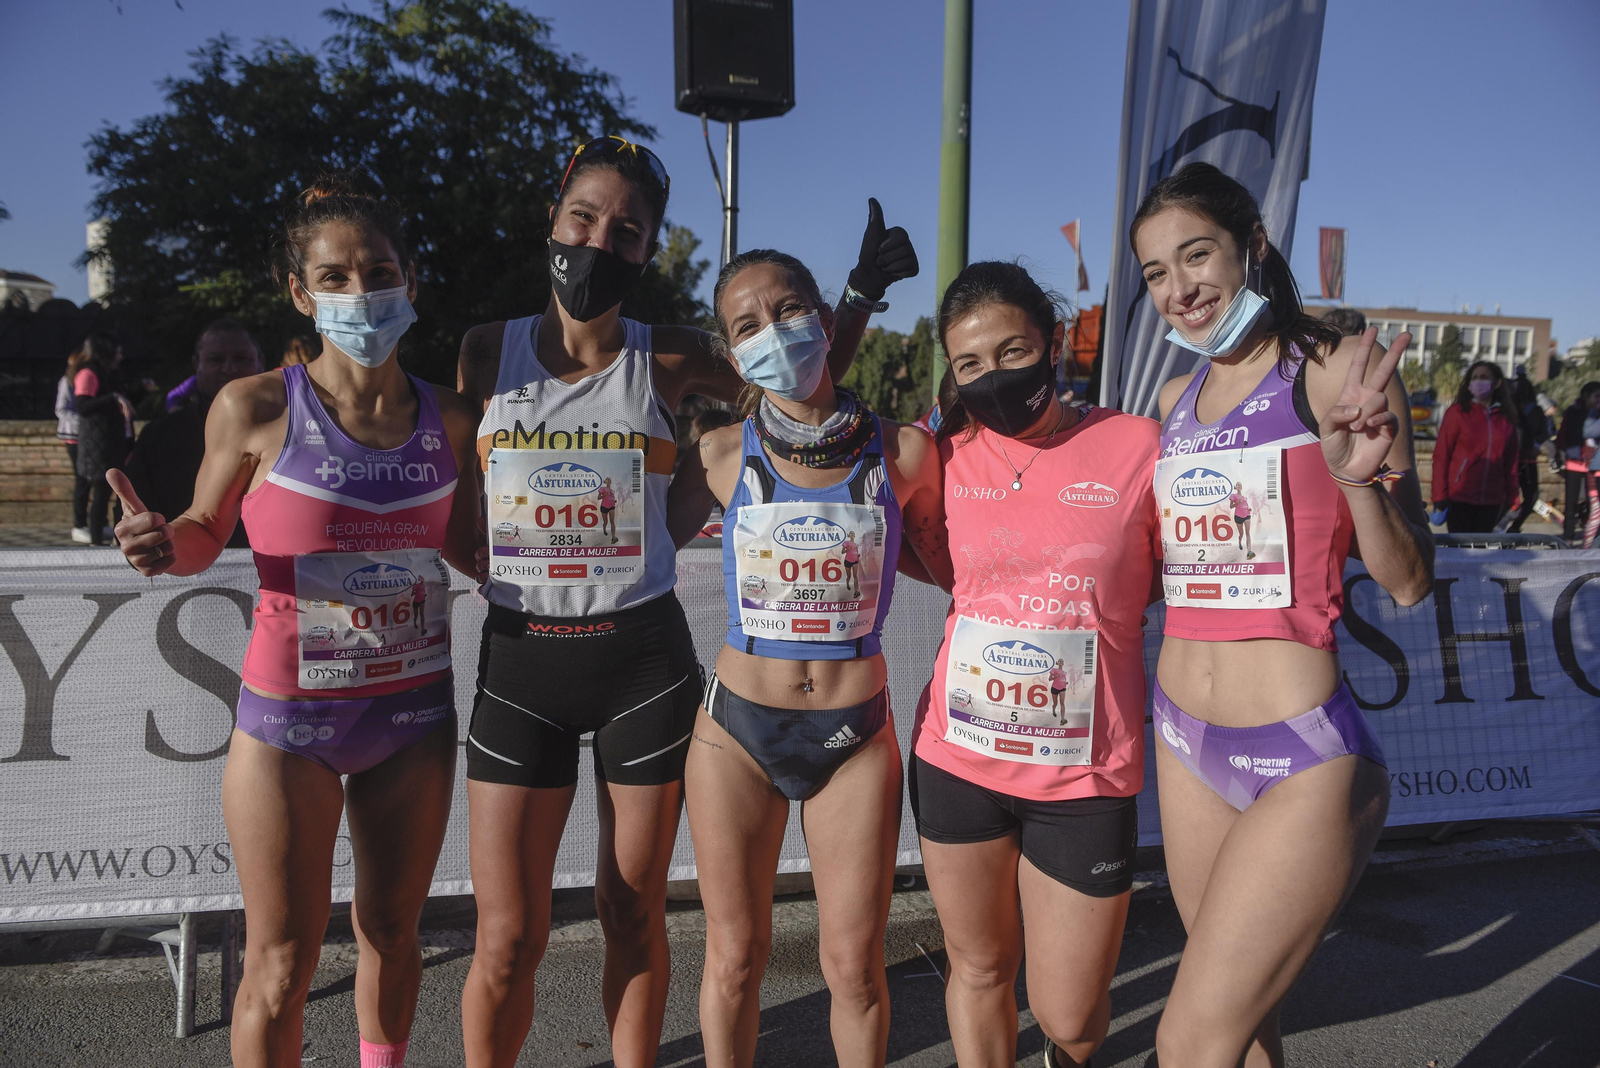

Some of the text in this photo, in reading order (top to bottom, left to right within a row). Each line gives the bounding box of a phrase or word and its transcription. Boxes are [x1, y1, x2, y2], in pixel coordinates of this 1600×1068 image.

[492, 420, 649, 456] eMotion
[534, 474, 597, 488] ASTURIANA
[954, 485, 1006, 500] OYSHO
[1063, 490, 1115, 503] ASTURIANA
[1175, 484, 1227, 498] ASTURIANA
[535, 504, 598, 528] 016
[326, 520, 428, 536] PEQUEÑA GRAN
[1175, 515, 1233, 542] 016
[550, 535, 582, 546] 2834
[779, 529, 841, 542] ASTURIANA
[337, 537, 416, 551] REVOLUCIÓN
[519, 548, 557, 556] CARRERA
[1198, 549, 1206, 561] 2
[497, 565, 542, 576] OYSHO
[780, 559, 842, 582] 016
[1167, 564, 1255, 574] CARRERA DE LA MUJER
[349, 577, 413, 591] ASTURIANA
[1049, 572, 1095, 592] POR
[794, 589, 825, 600] 3697
[765, 602, 800, 611] CARRERA
[831, 602, 859, 611] MUJER
[1018, 595, 1092, 616] TODAS
[351, 602, 411, 630] 016
[527, 622, 615, 632] WONG
[746, 617, 785, 630] OYSHO
[381, 634, 386, 645] 1
[527, 629, 617, 638] PERFORMANCE
[334, 639, 428, 659] CARRERA DE LA MUJER
[988, 649, 1049, 668] ASTURIANA
[308, 668, 358, 679] OYSHO
[986, 679, 1048, 708] 016
[263, 714, 337, 724] Club Atletismo
[1011, 712, 1018, 722] 5
[970, 716, 1066, 737] CARRERA DE LA MUJER
[293, 729, 329, 740] betta
[954, 726, 989, 746] OYSHO
[824, 735, 861, 749] adidas
[1006, 743, 1028, 752] Santander
[1253, 758, 1291, 767] SPORTING
[1254, 767, 1289, 777] PURSUITS
